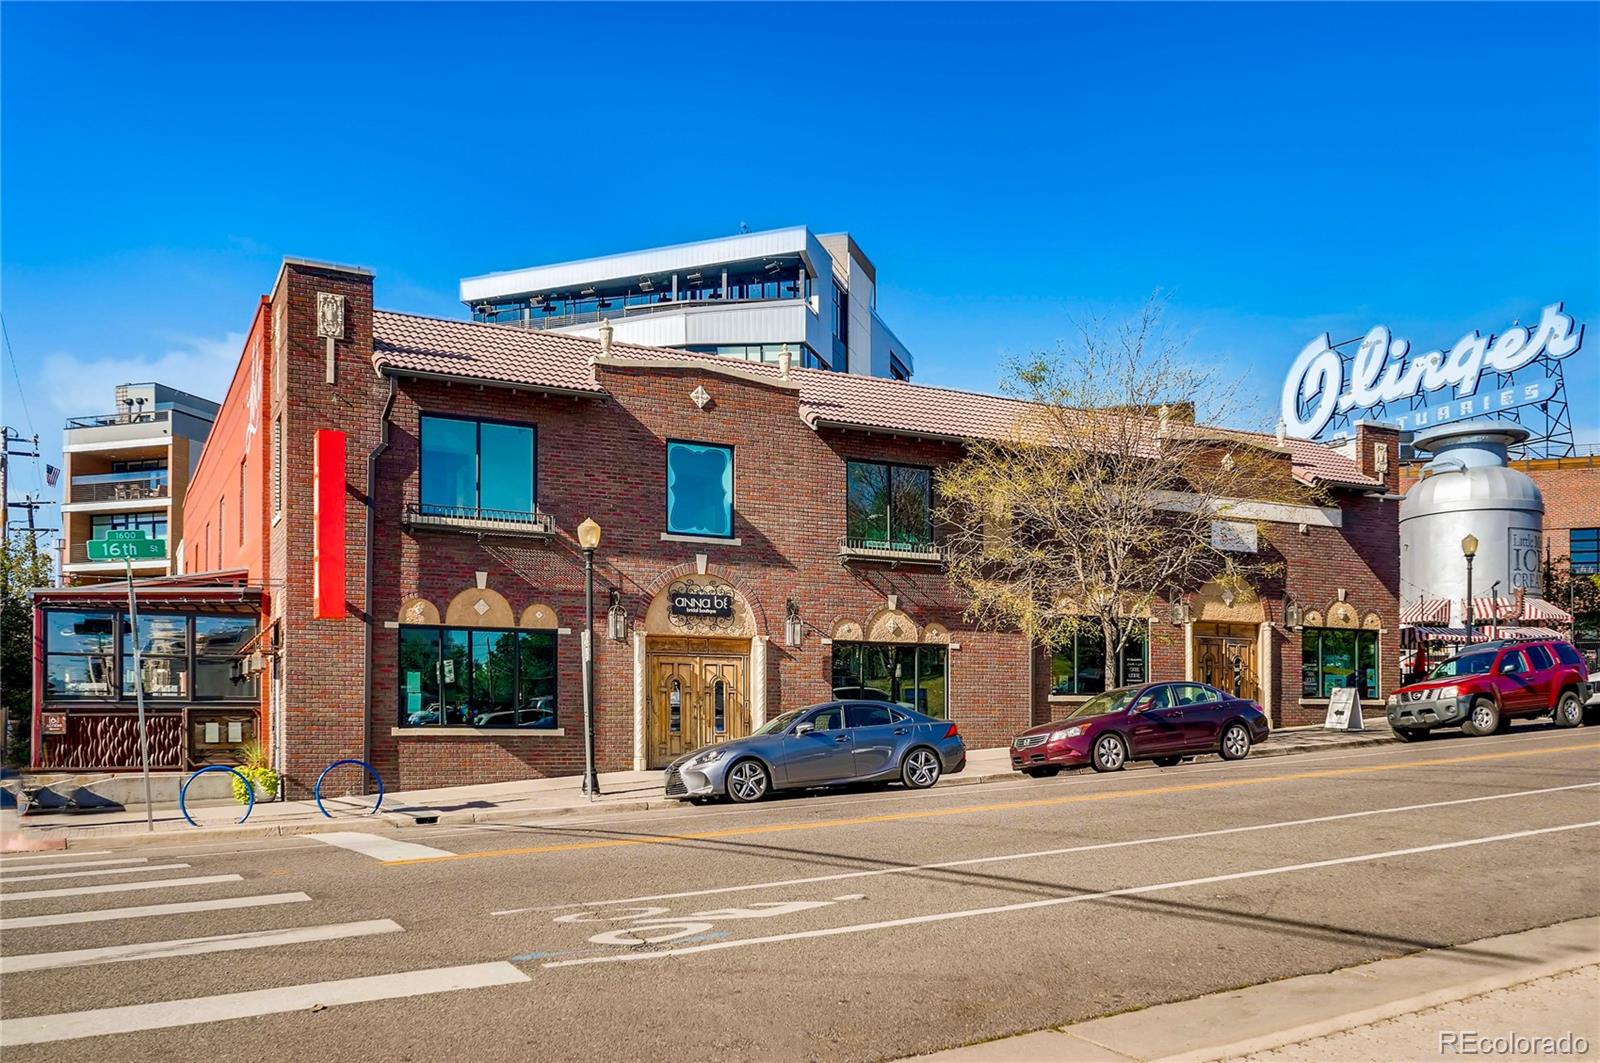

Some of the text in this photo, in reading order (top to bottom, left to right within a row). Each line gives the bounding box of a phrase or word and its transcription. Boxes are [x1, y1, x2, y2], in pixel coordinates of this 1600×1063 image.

[1280, 301, 1585, 440] Olinger
[1512, 534, 1534, 548] Little
[102, 543, 137, 556] 16th
